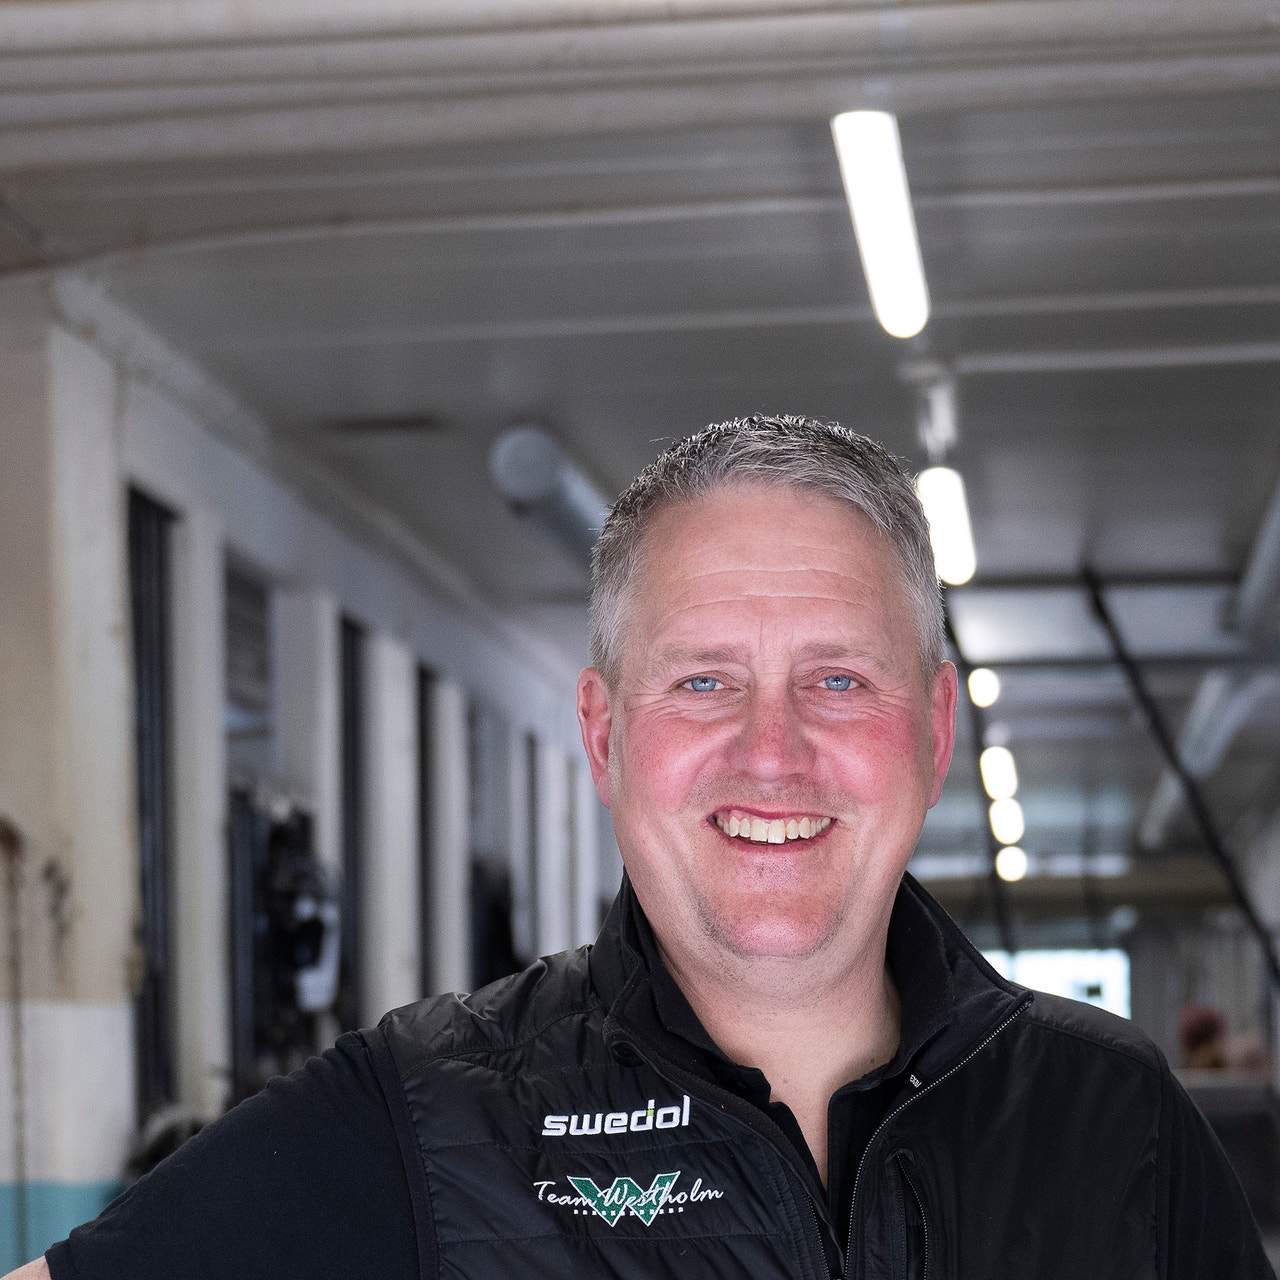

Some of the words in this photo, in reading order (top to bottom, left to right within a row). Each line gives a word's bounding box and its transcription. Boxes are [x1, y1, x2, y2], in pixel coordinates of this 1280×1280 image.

[542, 1095, 691, 1136] swedol
[533, 1180, 596, 1206] Team
[597, 1178, 724, 1207] Westholm
